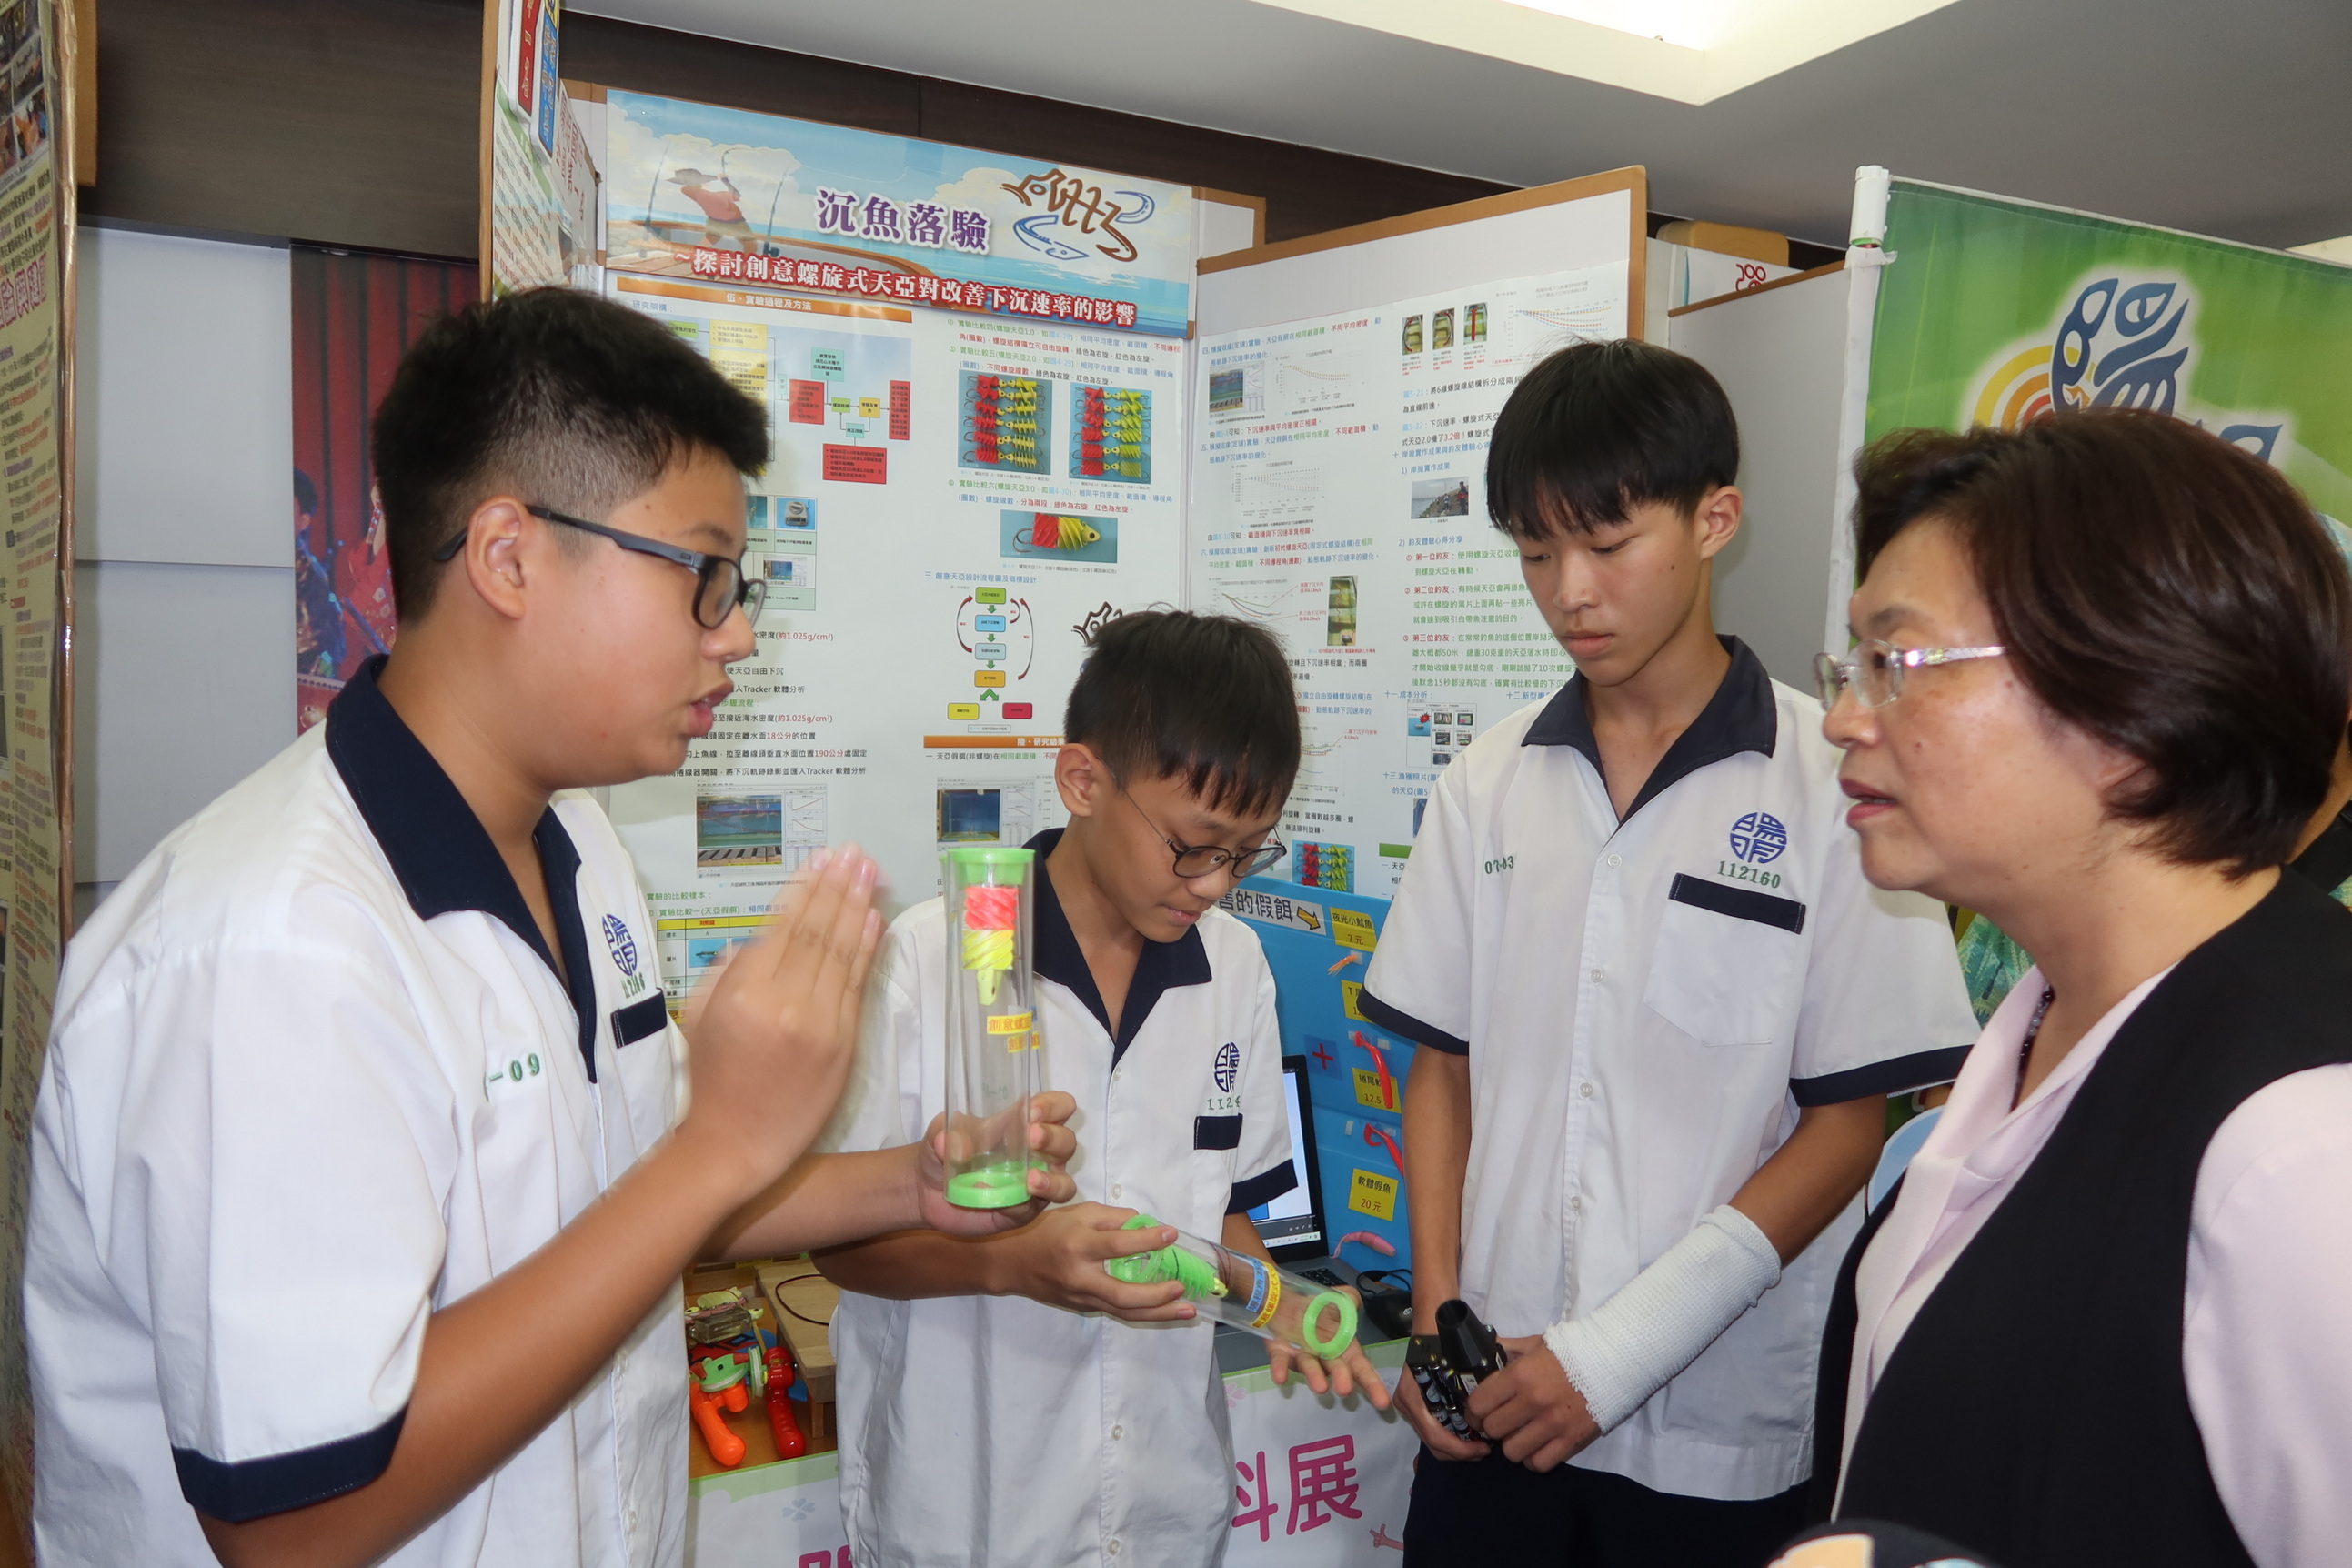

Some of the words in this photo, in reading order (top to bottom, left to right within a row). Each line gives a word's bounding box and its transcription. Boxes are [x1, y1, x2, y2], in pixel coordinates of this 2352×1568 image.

[818, 189, 989, 252] 沉魚落驗
[727, 292, 811, 311] 伍、實驗過程及方法
[731, 685, 771, 694] 入Tracker
[773, 685, 805, 694] 軟體分析
[836, 766, 867, 775] 軟體分析
[1717, 860, 1781, 889] 112160
[1348, 934, 1352, 943] 7
[1355, 935, 1363, 945] 元
[1364, 1093, 1382, 1104] 12.5
[1360, 1198, 1372, 1210] 20
[1373, 1201, 1382, 1213] 元
